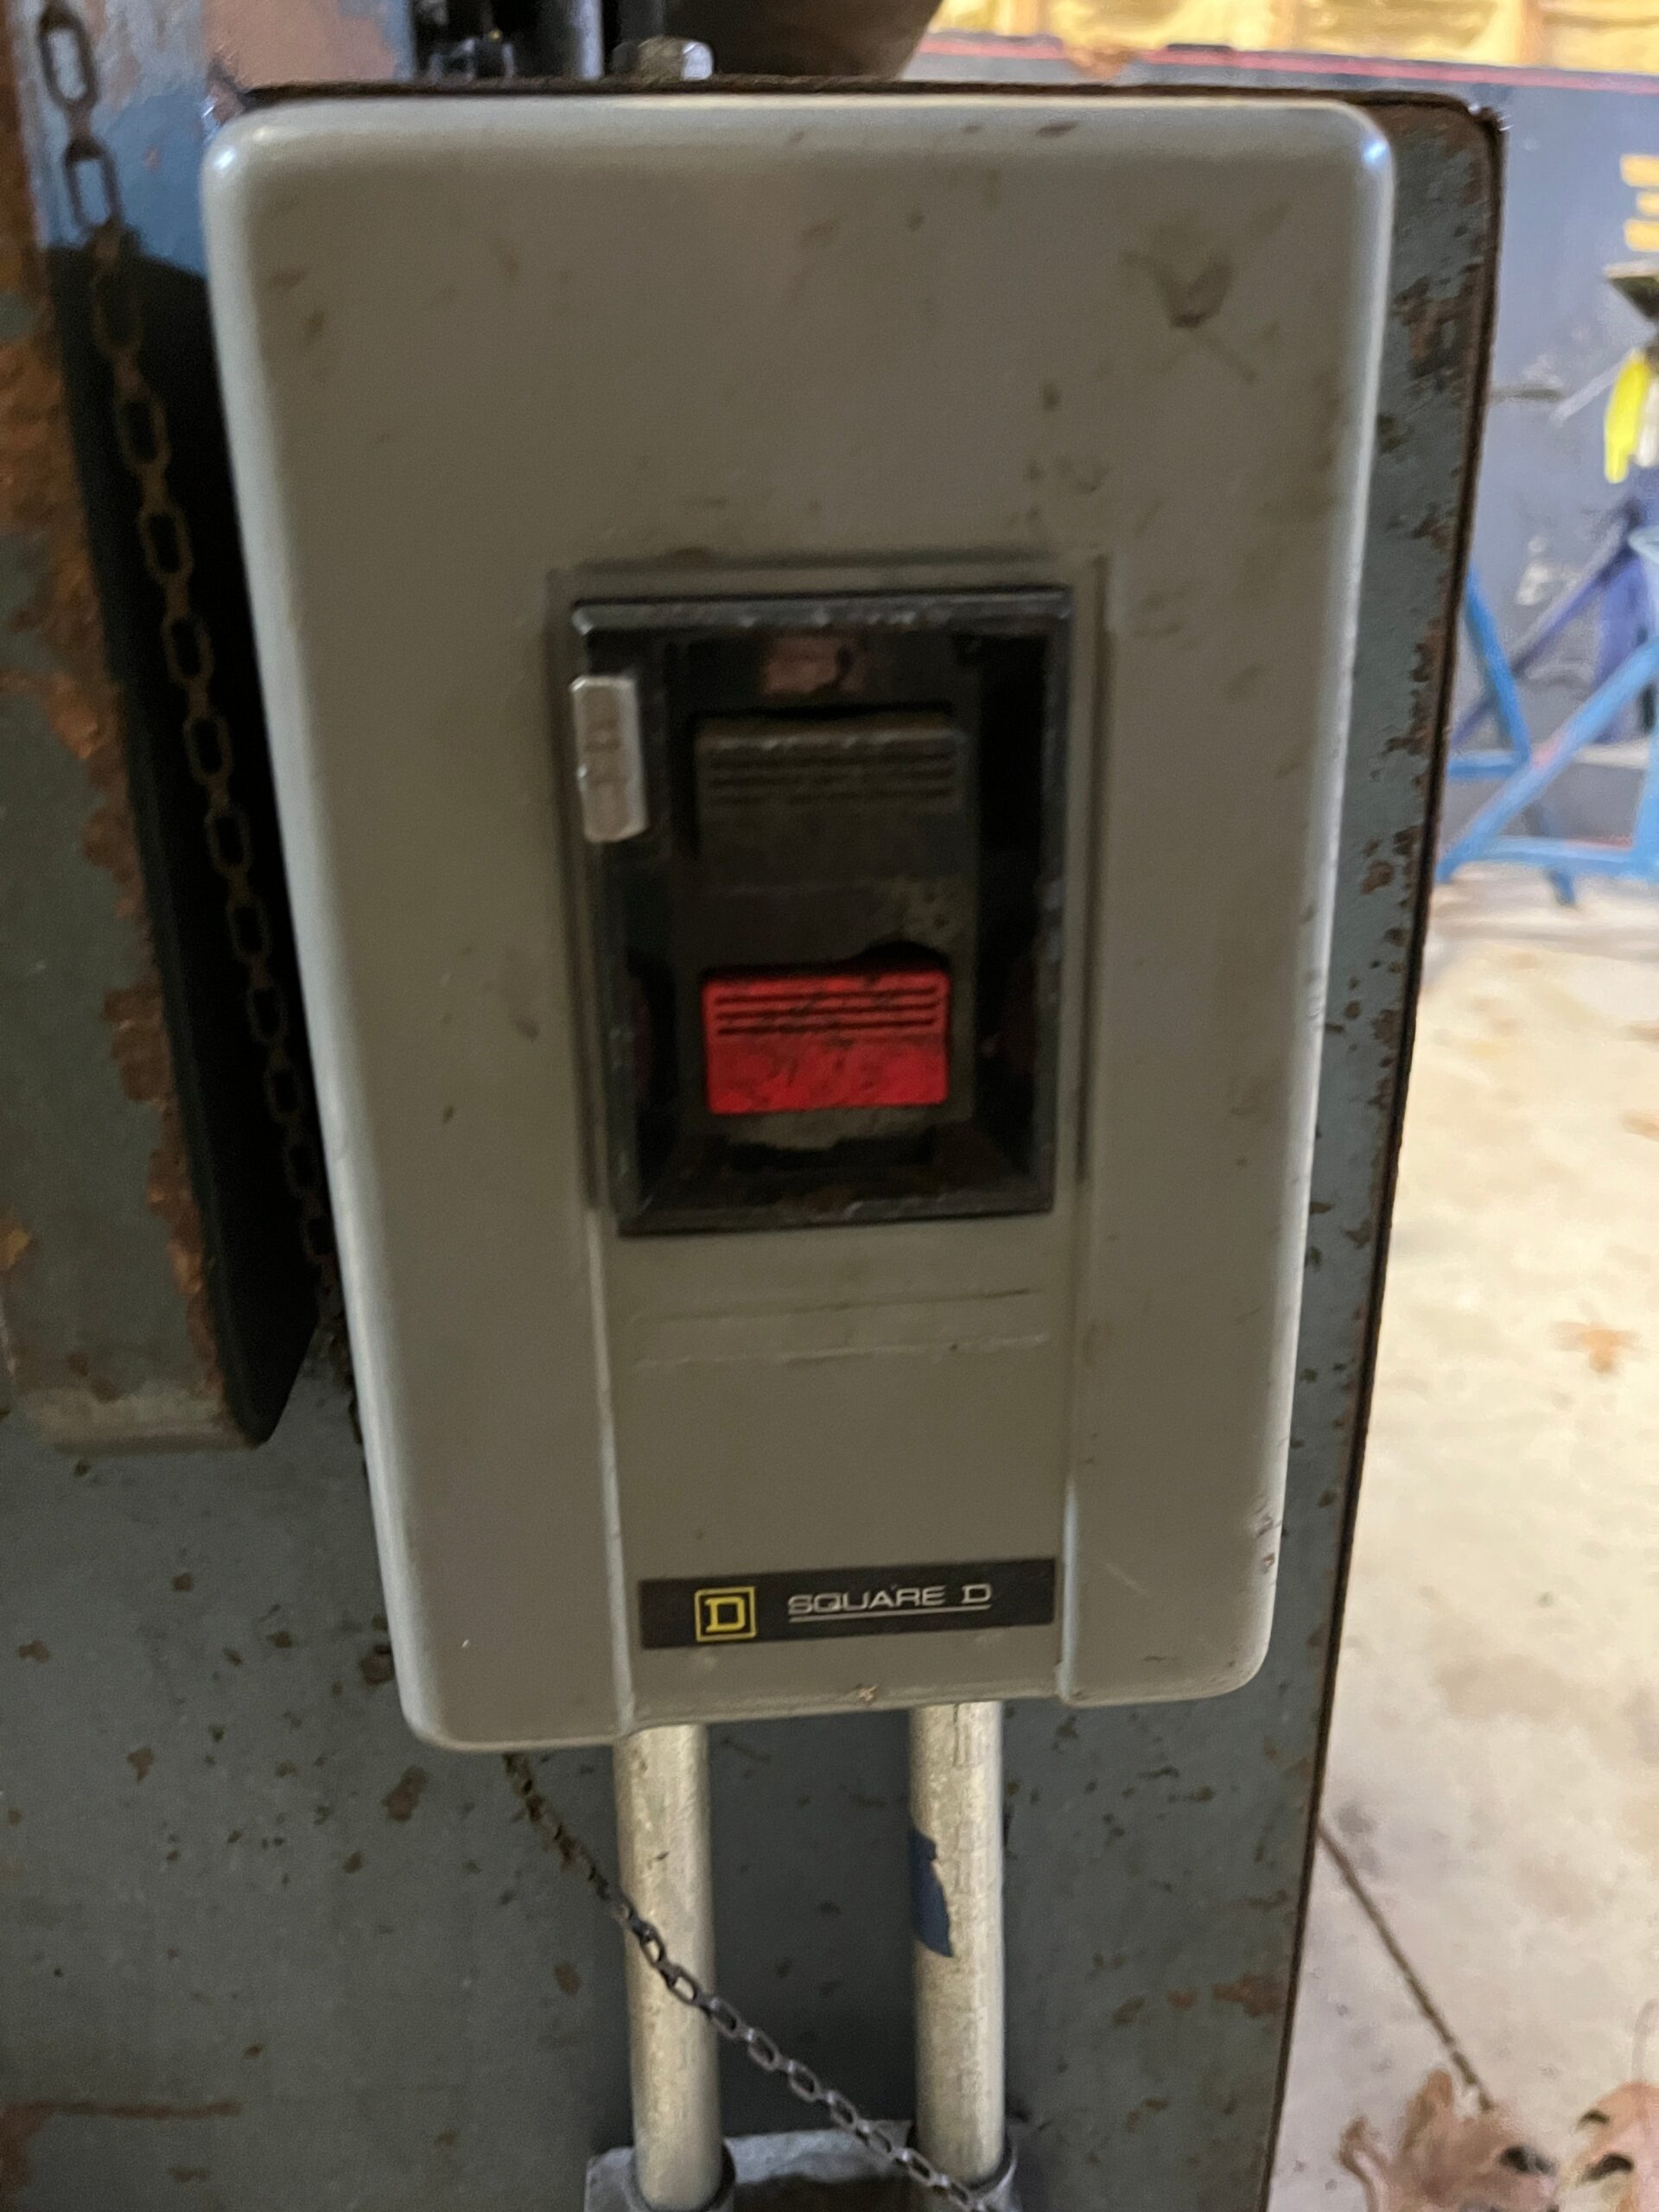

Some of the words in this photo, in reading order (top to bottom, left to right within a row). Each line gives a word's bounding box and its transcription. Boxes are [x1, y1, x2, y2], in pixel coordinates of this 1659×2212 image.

[704, 1596, 746, 1633] D
[787, 1586, 946, 1615] SQUARE
[961, 1583, 993, 1605] D
